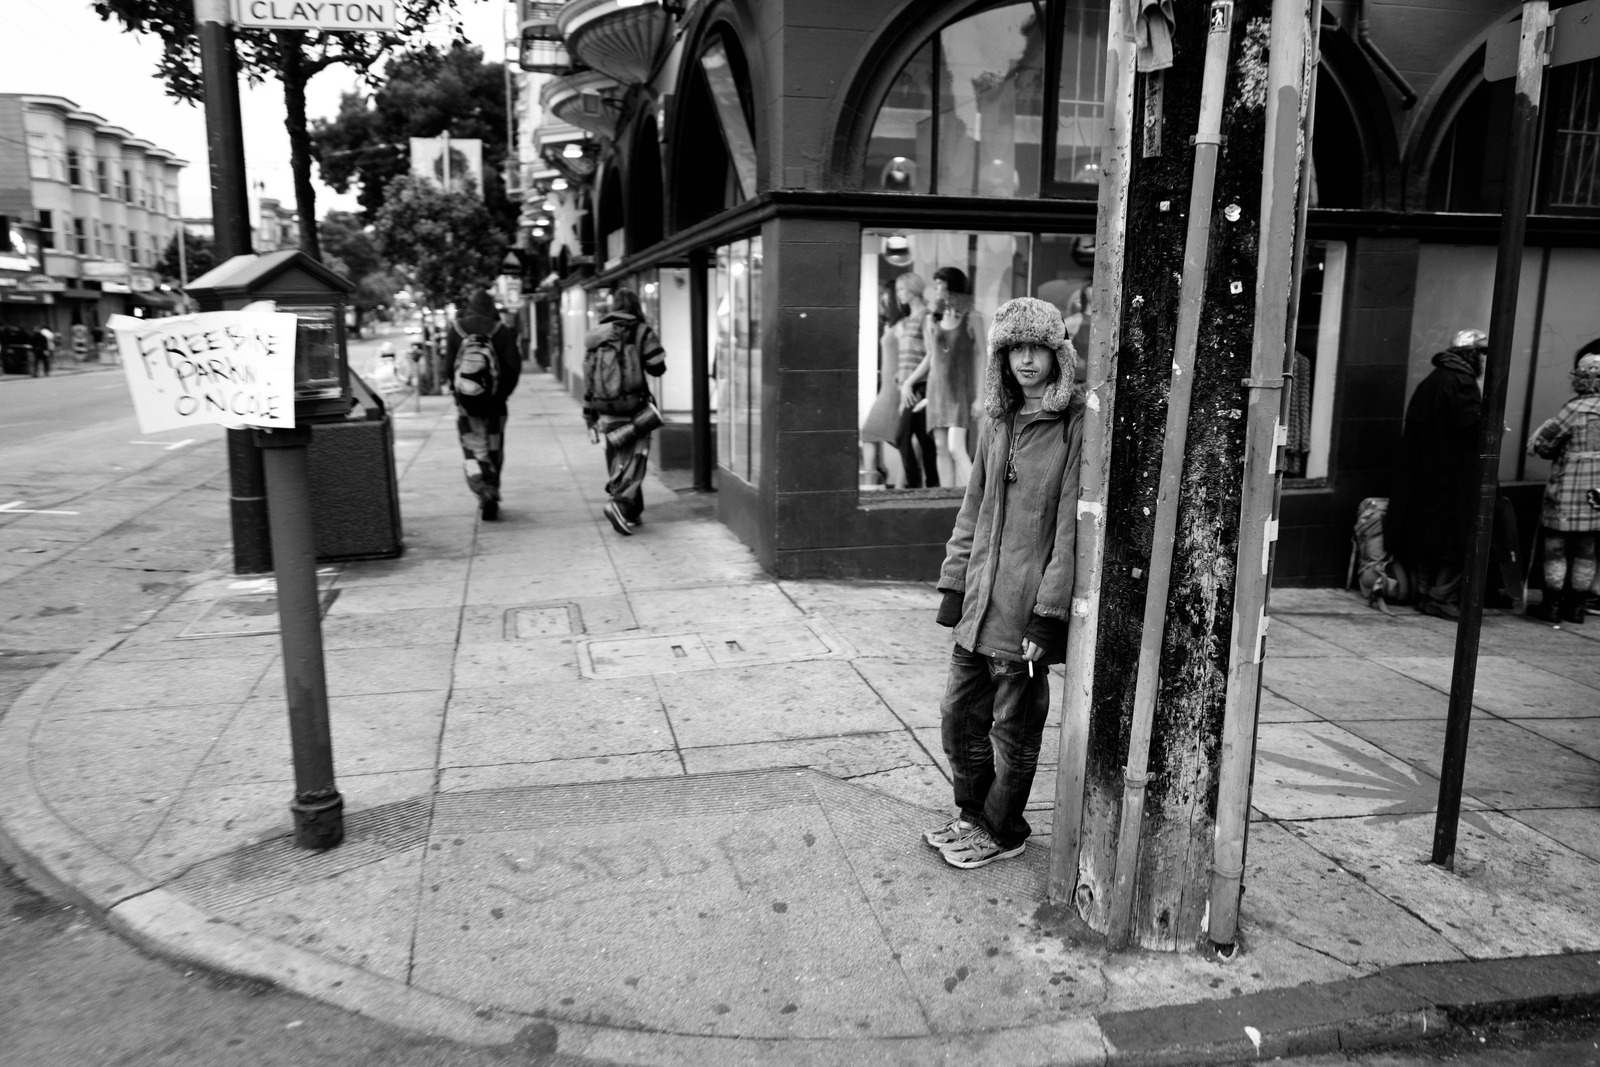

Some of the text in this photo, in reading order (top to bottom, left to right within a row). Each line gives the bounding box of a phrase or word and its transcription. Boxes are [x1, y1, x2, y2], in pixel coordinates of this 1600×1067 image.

[251, 1, 384, 22] CLAYTON
[134, 330, 224, 381] FREE
[174, 388, 227, 417] ON
